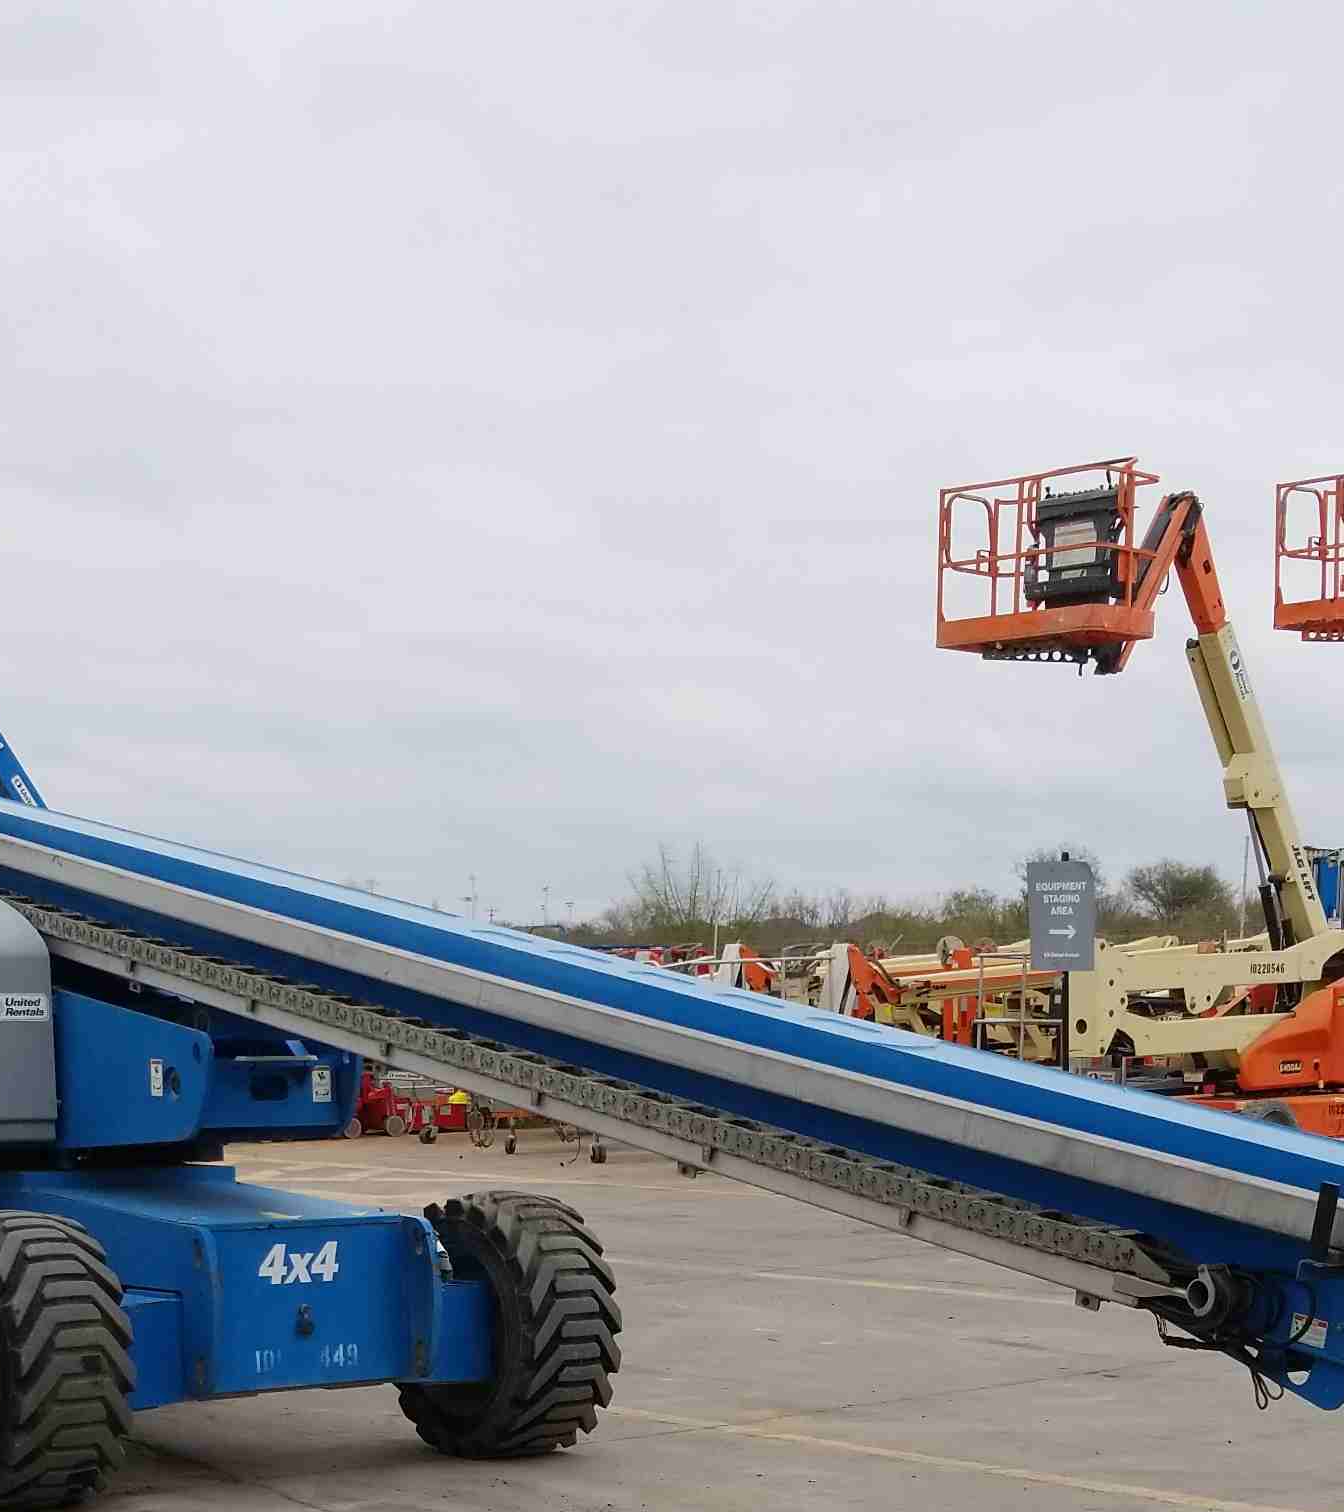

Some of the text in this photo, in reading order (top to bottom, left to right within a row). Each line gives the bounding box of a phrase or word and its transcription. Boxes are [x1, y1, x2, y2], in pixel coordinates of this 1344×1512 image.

[1035, 881, 1087, 891] EQUIPMENT
[1043, 894, 1080, 904] STAGING
[1050, 906, 1074, 915] AREA
[5, 998, 41, 1007] United
[5, 1008, 45, 1017] Rentals
[258, 1240, 339, 1285] 4x4
